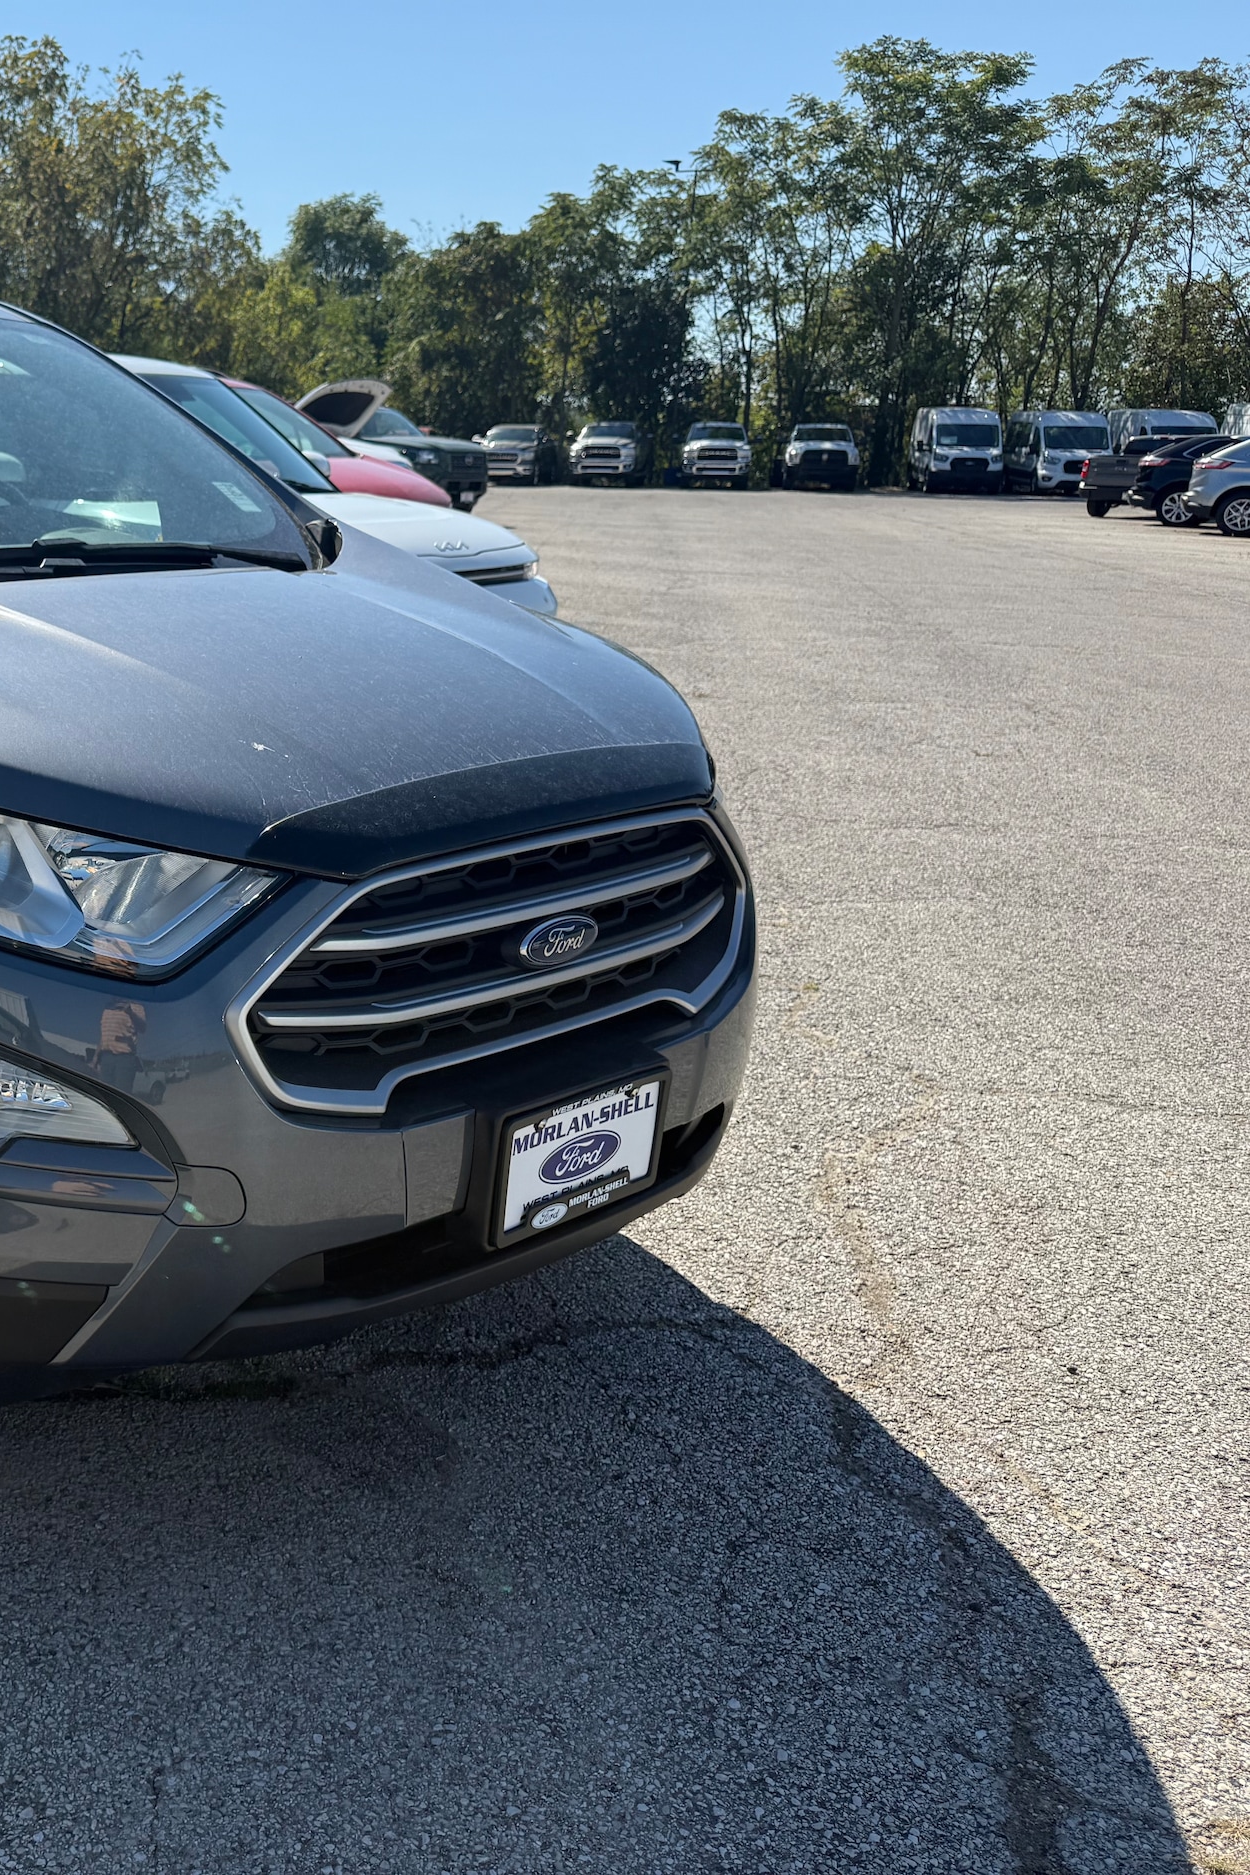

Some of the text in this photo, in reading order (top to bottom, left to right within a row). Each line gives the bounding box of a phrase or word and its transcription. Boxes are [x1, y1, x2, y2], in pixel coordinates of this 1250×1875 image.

[543, 924, 586, 957] Ford
[512, 1092, 655, 1157] MORLAN-SHELL
[552, 1100, 580, 1117] WEST
[555, 1138, 606, 1177] Ford
[568, 1176, 629, 1208] MORLAN-SHELL
[587, 1193, 610, 1209] FORD
[539, 1207, 561, 1225] Ford
